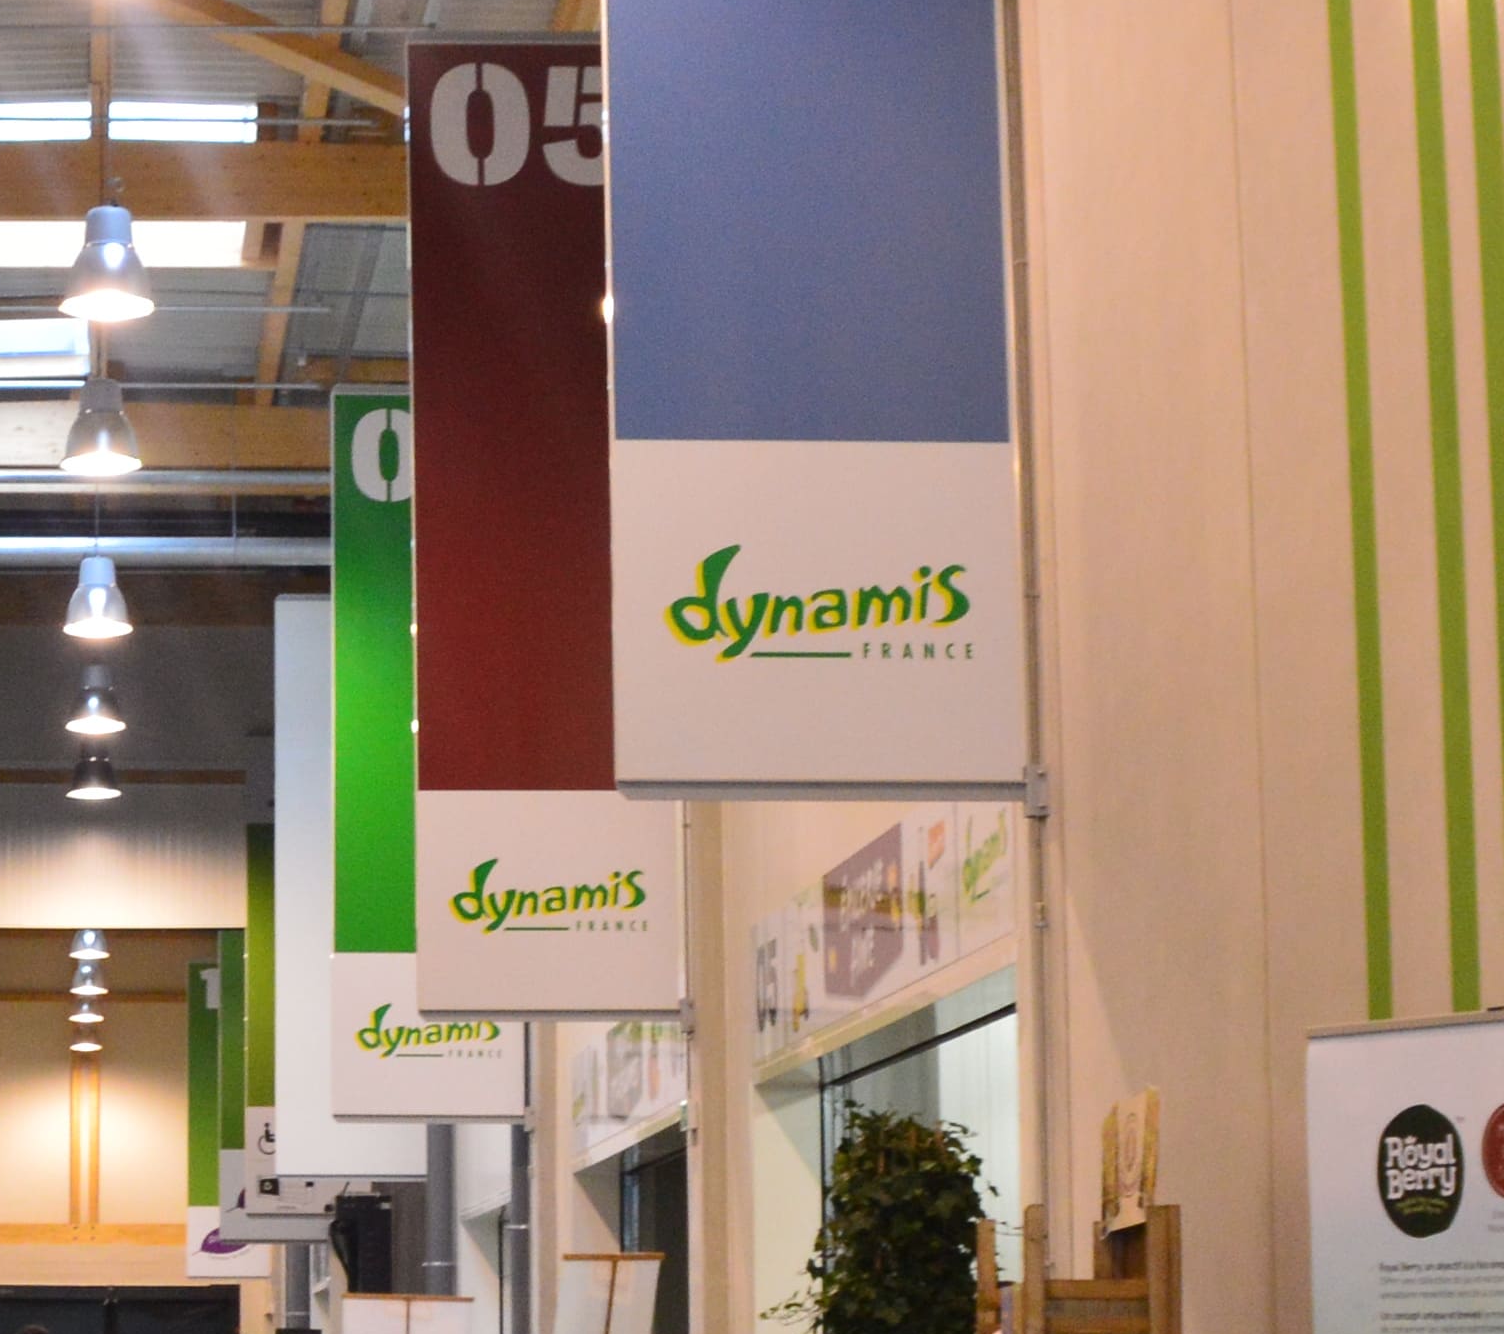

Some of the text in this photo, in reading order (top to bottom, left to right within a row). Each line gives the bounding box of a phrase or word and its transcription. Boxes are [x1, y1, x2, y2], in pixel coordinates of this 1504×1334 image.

[666, 543, 972, 661] dynamis
[862, 642, 976, 661] FRANCE
[452, 858, 647, 933] dynamis
[575, 919, 650, 933] FRANCE
[1384, 1133, 1457, 1168] Royal
[1386, 1167, 1457, 1200] Berry
